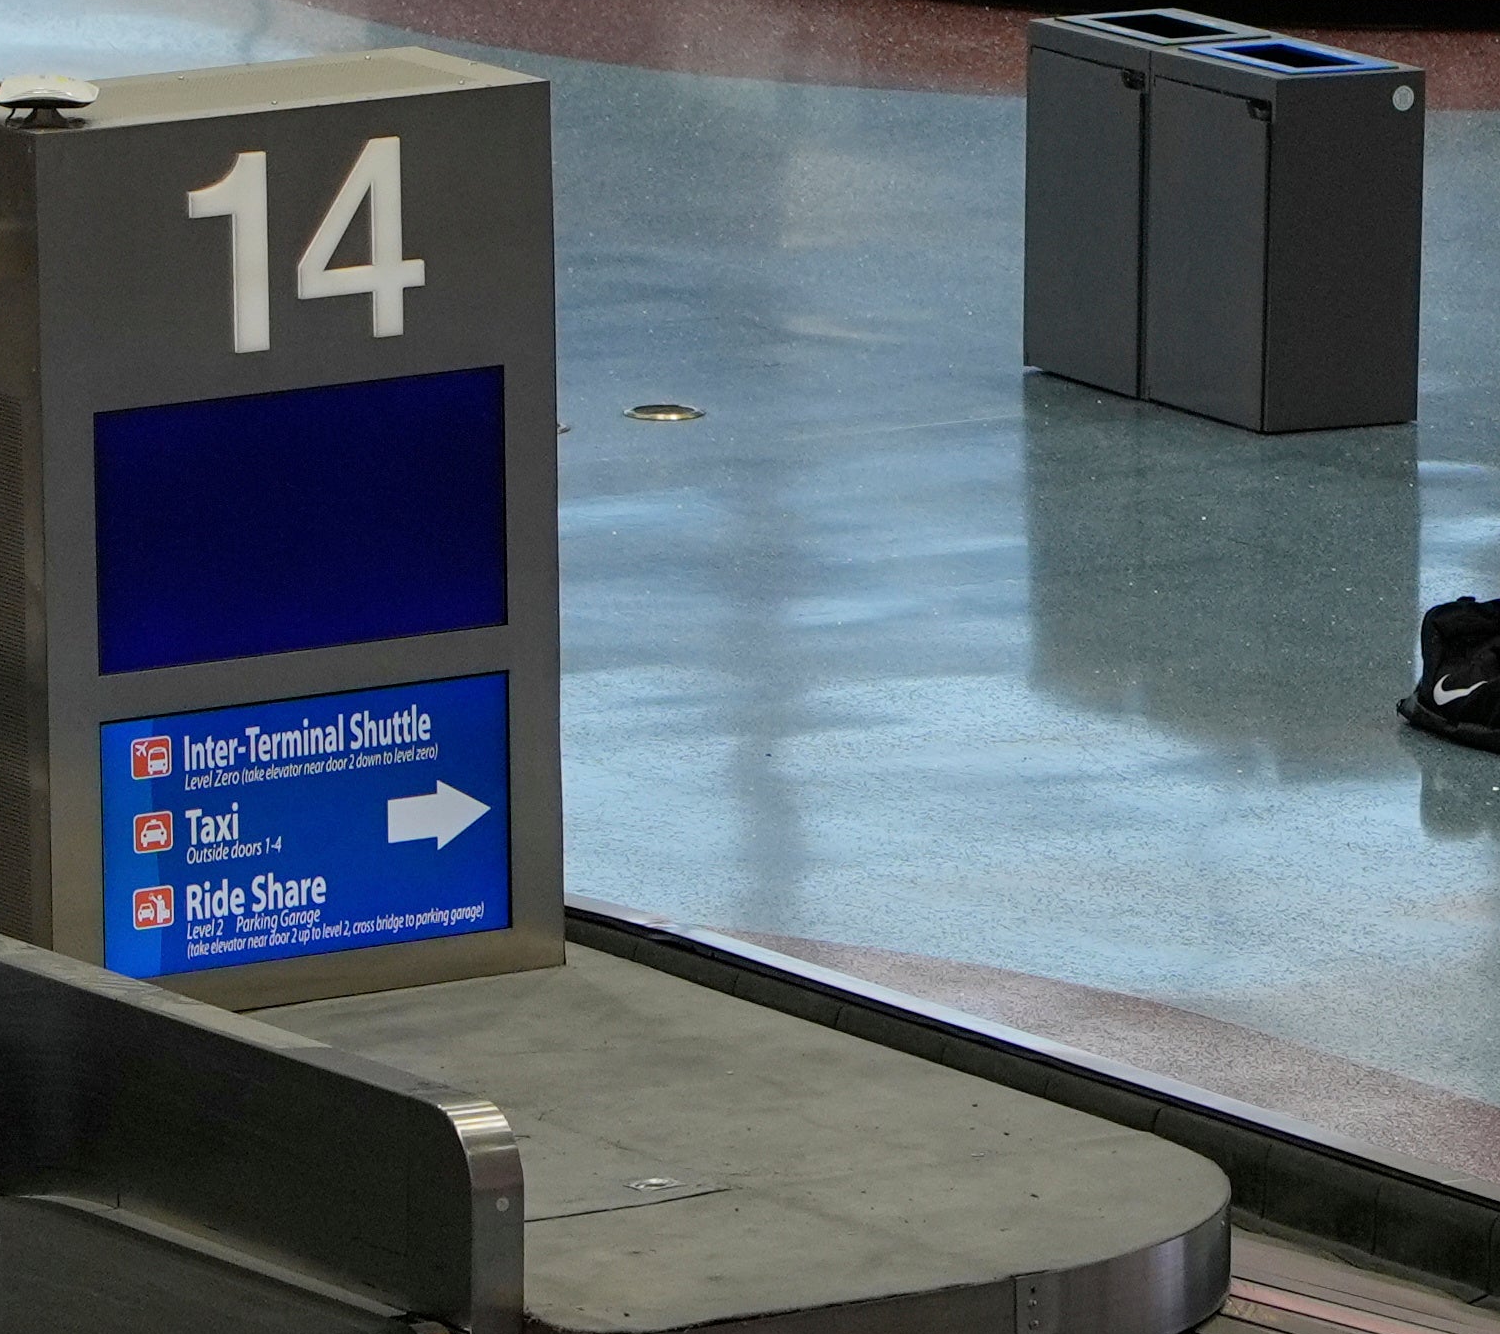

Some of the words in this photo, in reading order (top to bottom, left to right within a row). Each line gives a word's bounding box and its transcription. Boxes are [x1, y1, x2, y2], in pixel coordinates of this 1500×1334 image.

[186, 135, 427, 355] 14
[183, 714, 346, 772] Inter-Terminal
[350, 704, 432, 748] Shuttle
[184, 772, 213, 791] Level
[214, 771, 240, 788] Zero
[242, 766, 264, 786] (take
[266, 763, 302, 781] elevator
[303, 761, 325, 775] near
[326, 757, 347, 773] door
[349, 756, 355, 770] 2
[357, 753, 381, 769] down
[383, 751, 393, 765] to
[394, 748, 415, 764] level
[416, 743, 439, 762] zero)
[185, 802, 239, 847] Taxi
[186, 846, 229, 865] Outside
[231, 841, 262, 860] doors
[265, 836, 282, 856] 1-4
[186, 880, 246, 922] Ride
[251, 872, 327, 914] Share
[187, 920, 217, 940] Level
[217, 920, 224, 935] 2
[236, 913, 279, 935] Parking
[280, 908, 321, 930] Garage
[187, 939, 210, 959] (take
[210, 934, 246, 955] elevator
[247, 934, 268, 950] near
[269, 929, 290, 947] door
[291, 928, 298, 944] 2
[299, 930, 311, 948] up
[311, 927, 321, 942] to
[322, 923, 342, 941] level
[353, 920, 375, 935] cross
[376, 914, 405, 936] bridge
[405, 913, 415, 928] to
[415, 907, 451, 930] parking
[451, 901, 484, 925] garage)
